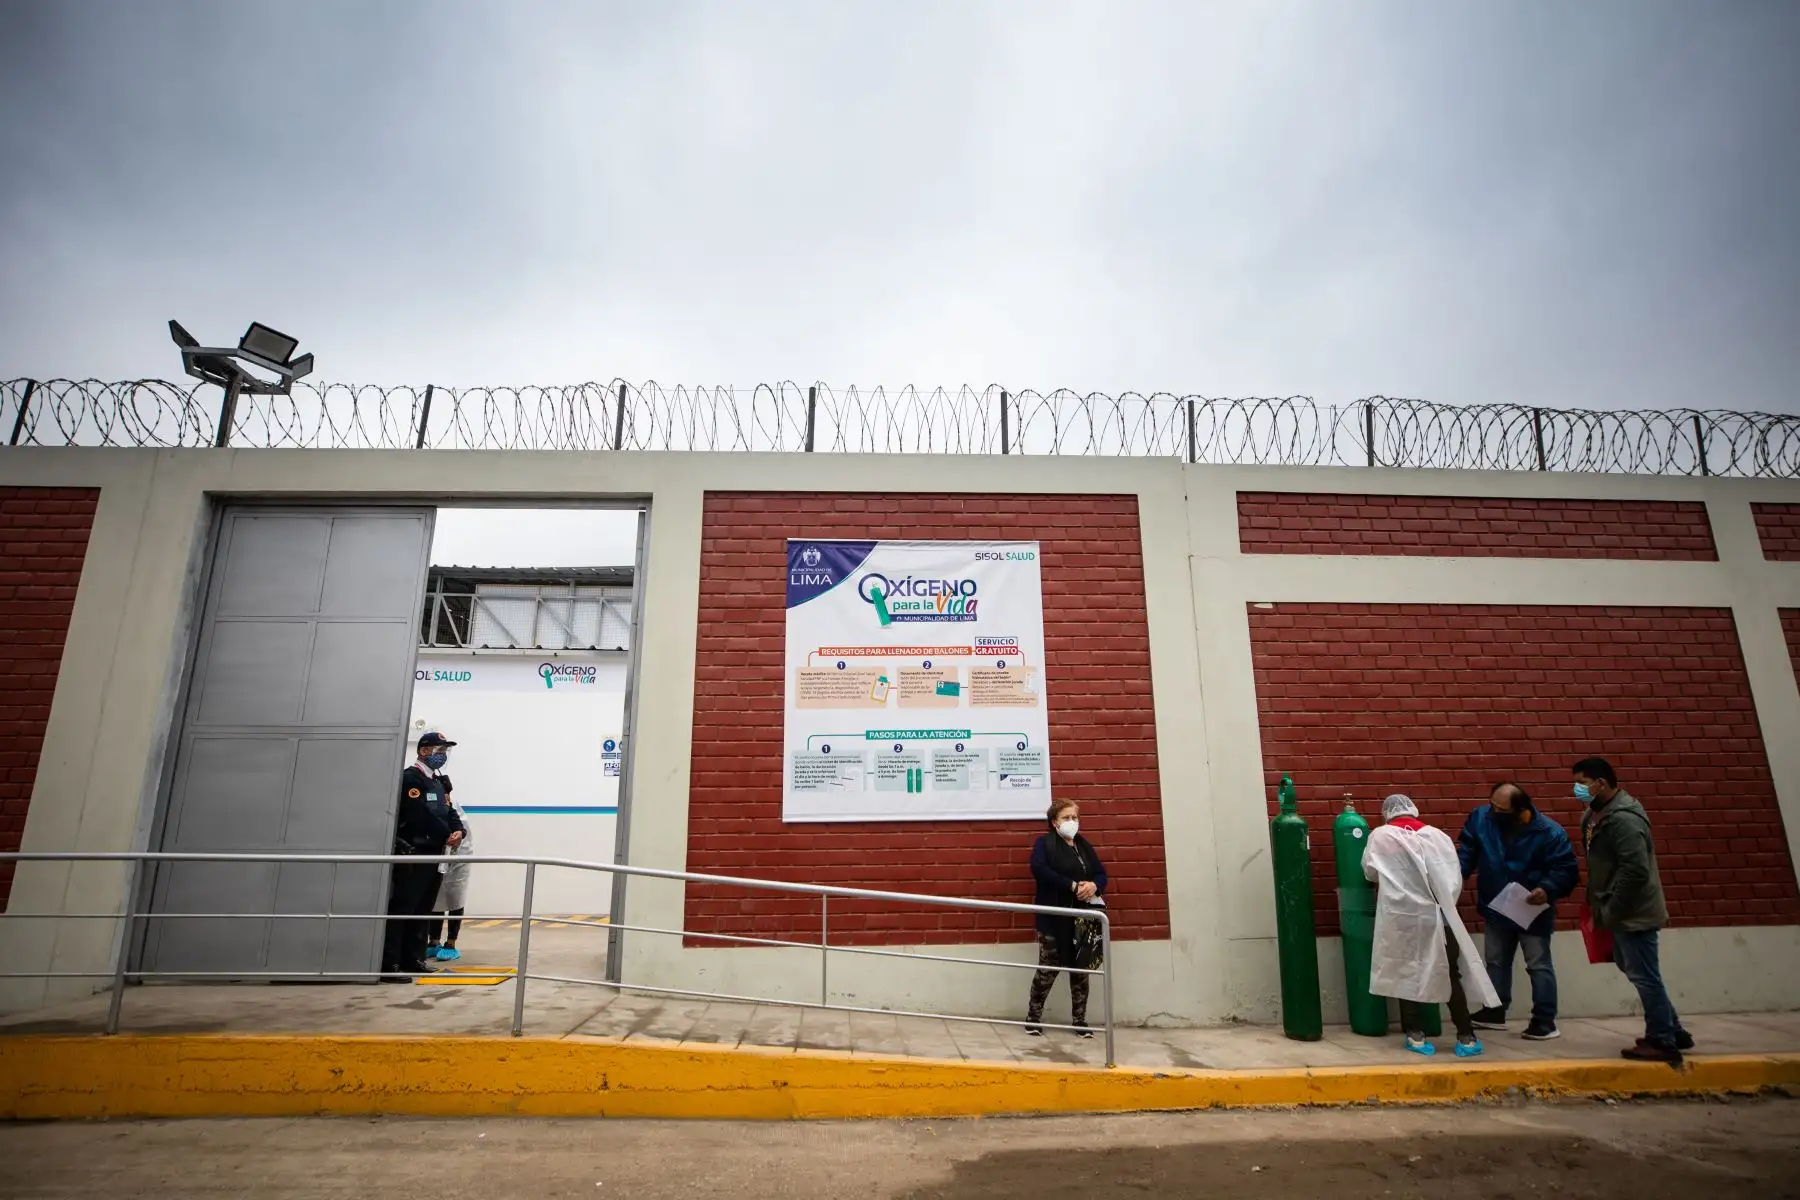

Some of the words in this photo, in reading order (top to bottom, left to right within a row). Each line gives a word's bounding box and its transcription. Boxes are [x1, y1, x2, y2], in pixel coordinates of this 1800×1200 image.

[975, 552, 1004, 561] SISOL
[1005, 552, 1035, 561] SALUD
[791, 574, 832, 585] LIMA
[858, 573, 977, 604] OXÍGENO
[892, 601, 920, 612] para
[924, 600, 934, 610] la
[936, 588, 978, 614] Vida
[434, 670, 472, 681] SALUD
[538, 662, 596, 678] OXÍGENO
[575, 672, 596, 684] Vida
